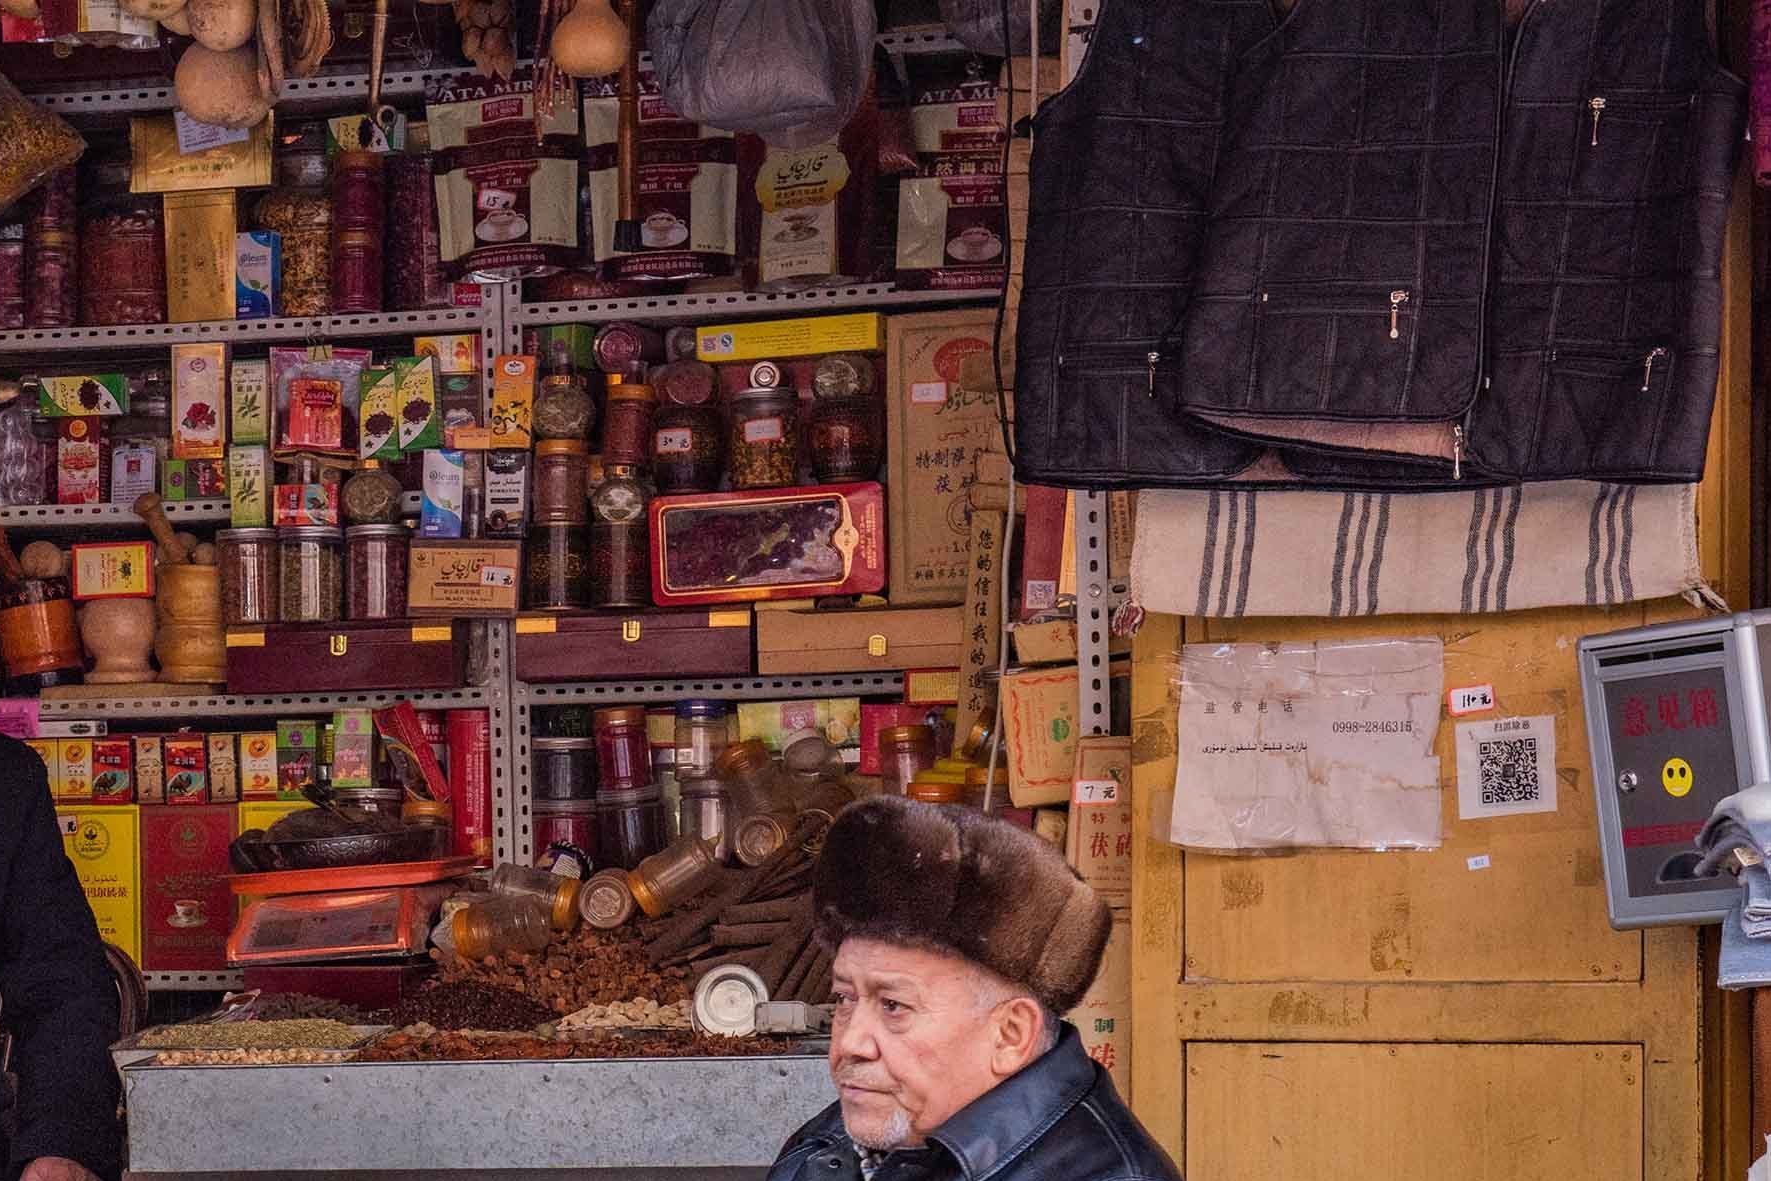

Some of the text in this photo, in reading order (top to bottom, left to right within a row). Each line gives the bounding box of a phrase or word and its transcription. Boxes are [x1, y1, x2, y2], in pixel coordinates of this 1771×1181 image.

[443, 80, 533, 102] ATA MIR
[920, 90, 964, 103] ATA
[916, 446, 966, 469] 特制萨
[1204, 700, 1293, 714] 监管电话
[1622, 688, 1717, 737] 意见箱
[1085, 786, 1116, 799] 7 元
[1091, 832, 1132, 858] 茯砖
